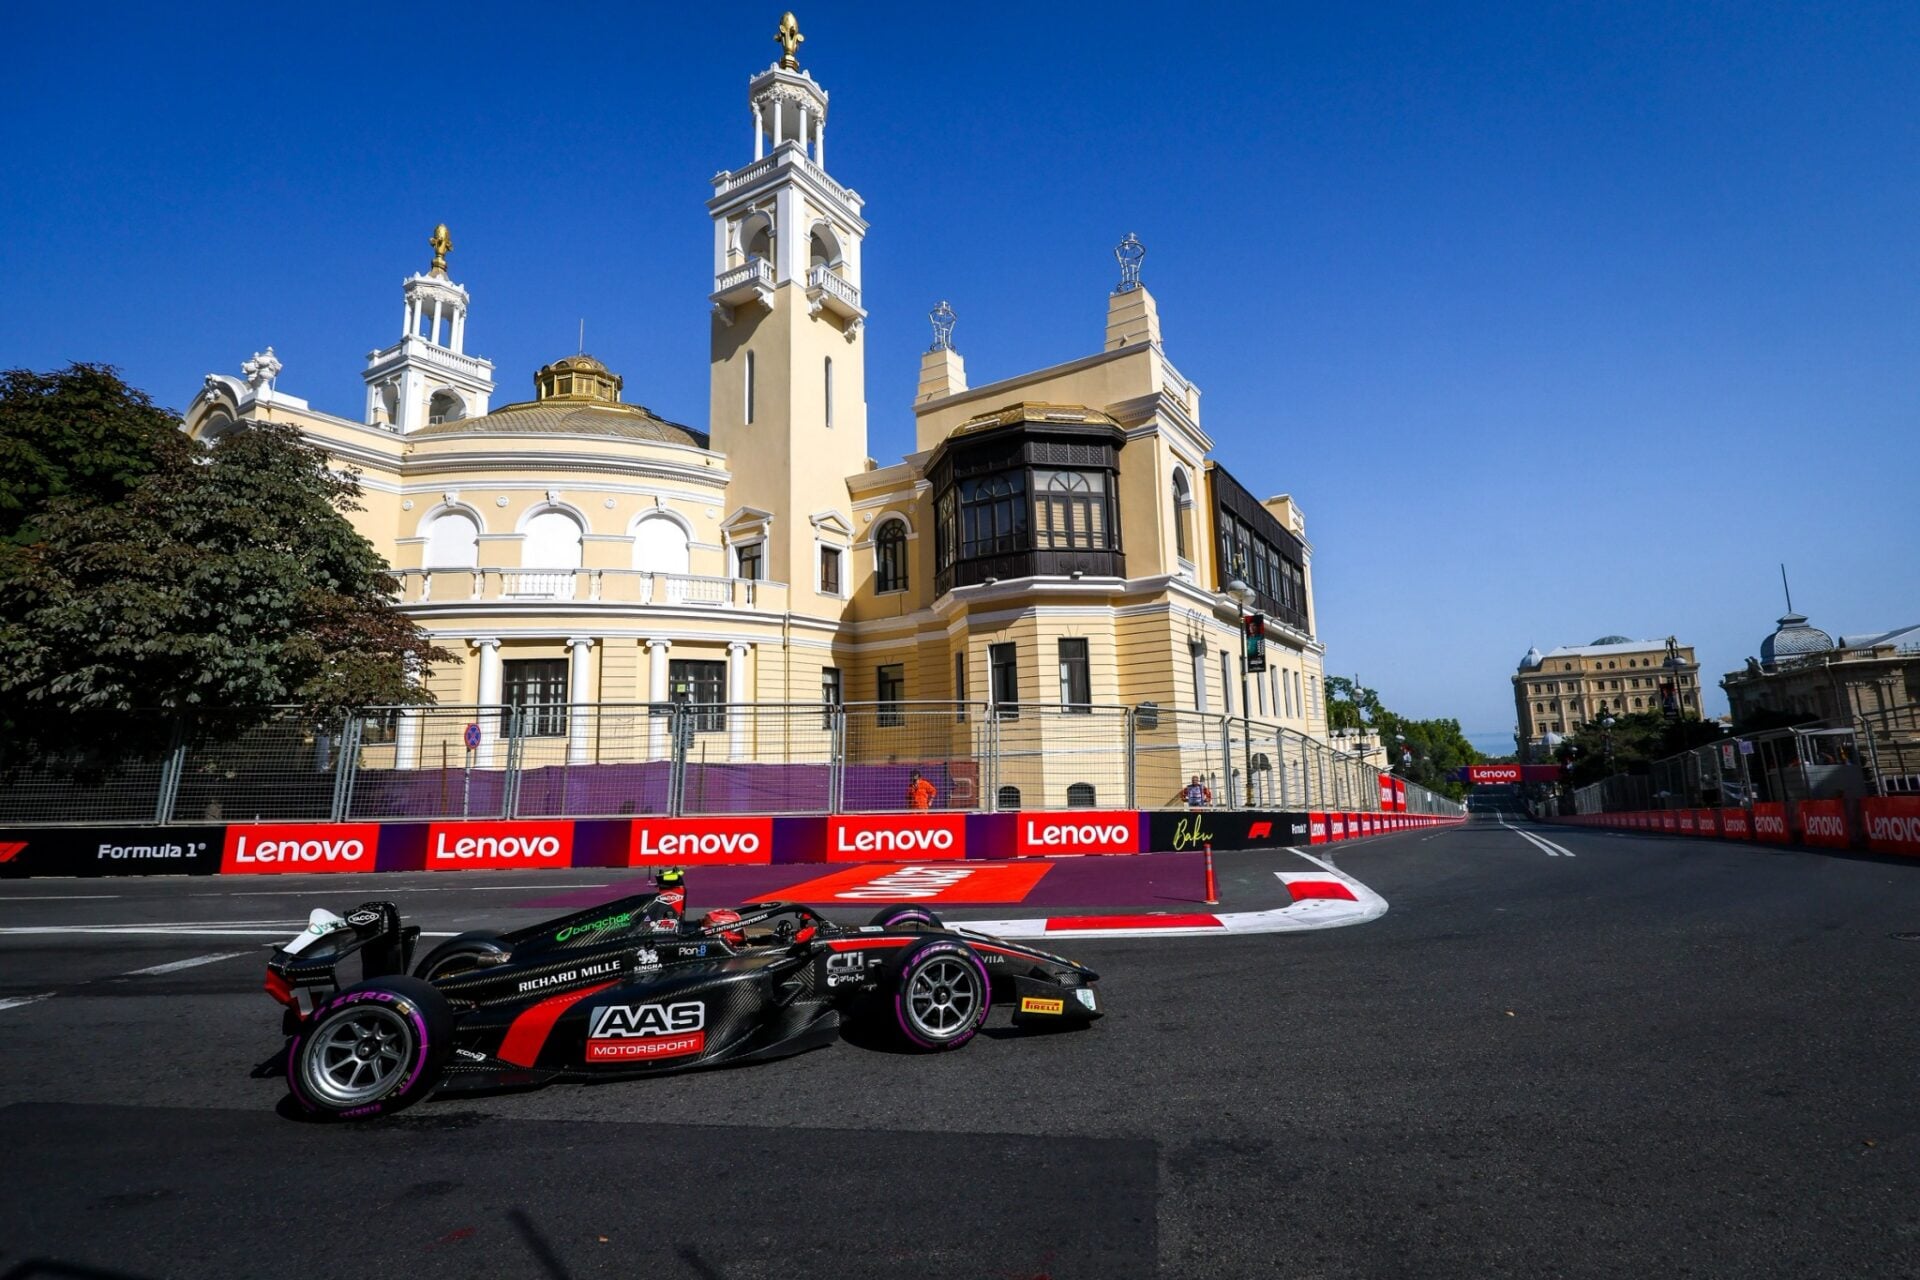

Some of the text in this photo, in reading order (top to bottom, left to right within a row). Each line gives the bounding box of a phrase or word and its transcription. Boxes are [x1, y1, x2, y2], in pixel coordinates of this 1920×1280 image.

[1473, 768, 1517, 780] Lenovo
[1027, 820, 1130, 846] Lenovo
[1172, 814, 1213, 850] Baku
[1723, 815, 1747, 832] Lenovo
[1803, 811, 1843, 836] Lenovo
[98, 843, 183, 859] Formula
[236, 836, 365, 863] Lenovo
[436, 832, 561, 859] Lenovo
[640, 829, 760, 856] Lenovo
[838, 826, 954, 852] Lenovo
[572, 913, 630, 936] bangchak
[518, 969, 577, 992] RICHARD
[581, 960, 621, 978] MILLE
[634, 962, 663, 972] SINGHA
[1025, 1000, 1060, 1012] PIRELLI
[591, 1001, 705, 1038] AAS
[594, 1039, 697, 1056] MOTORSPORT
